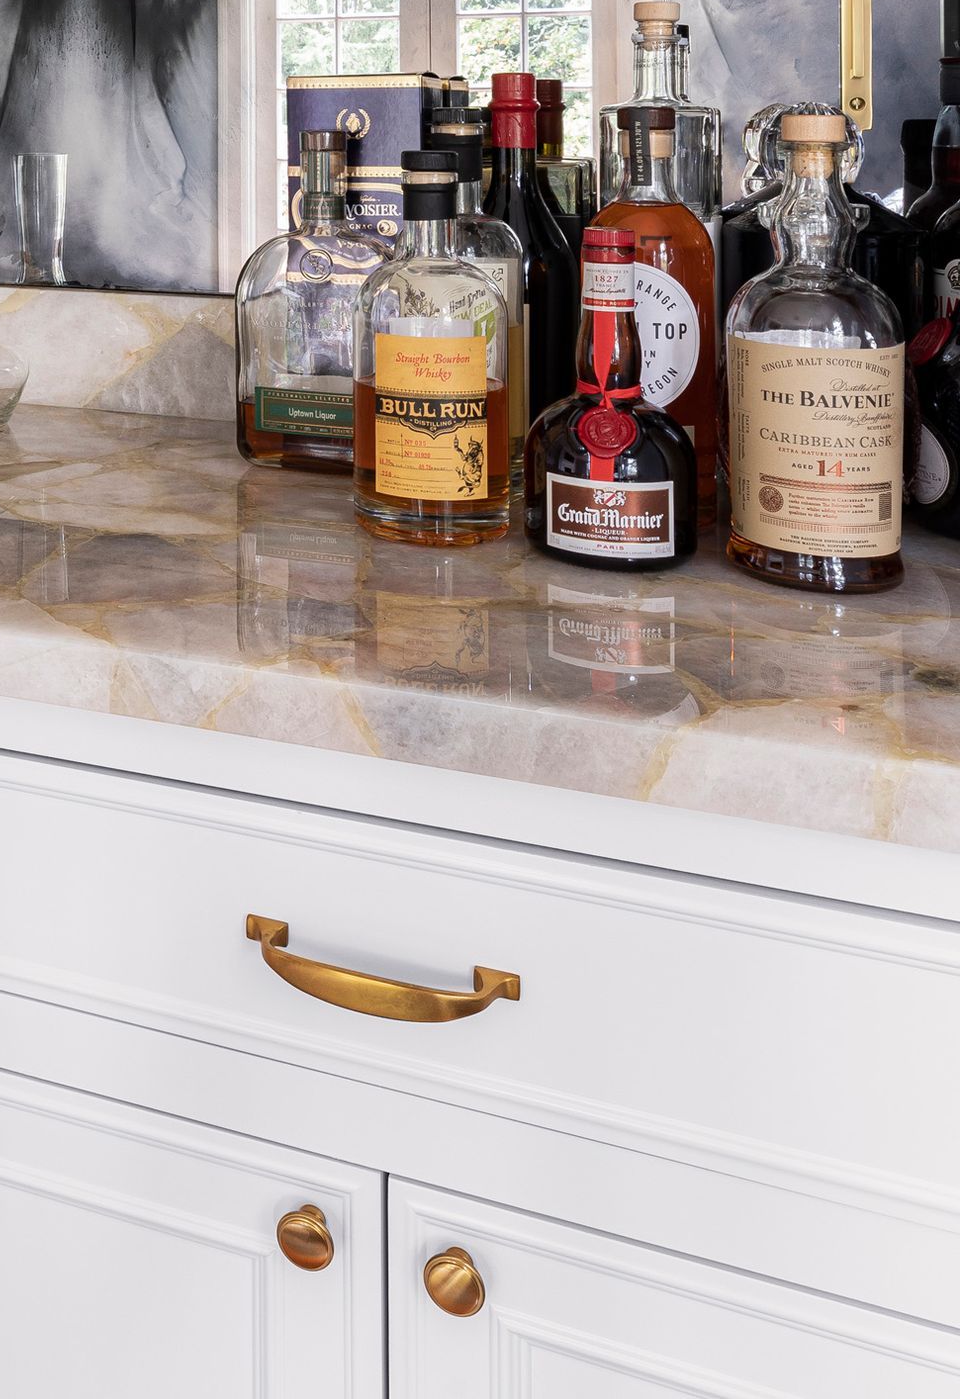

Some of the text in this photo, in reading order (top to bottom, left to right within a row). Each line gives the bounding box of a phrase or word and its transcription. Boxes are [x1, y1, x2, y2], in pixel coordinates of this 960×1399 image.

[345, 204, 401, 220] VOISIER.
[595, 275, 618, 283] 1827
[636, 279, 677, 312] RANGE
[652, 323, 688, 340] TOP
[395, 352, 429, 368] Straight
[433, 353, 470, 365] Bourbon
[761, 357, 892, 379] SINGLE MALT SCOTCH WHISKY
[414, 367, 453, 382] Whiskey
[640, 367, 678, 398] REGON
[760, 389, 893, 408] THE BALVENIE
[288, 407, 337, 421] Uptown Liquor
[380, 398, 485, 418] BULL RUN
[414, 419, 453, 429] DISTILLING
[760, 427, 892, 449] CARIBBEAN CASK
[801, 449, 833, 457] MATURED
[816, 459, 845, 477] 14
[557, 503, 664, 529] Grand Marnier
[560, 528, 574, 536] MADE
[574, 530, 587, 538] WITH
[587, 532, 608, 540] COGNAC
[594, 528, 626, 536] LIQUEUR
